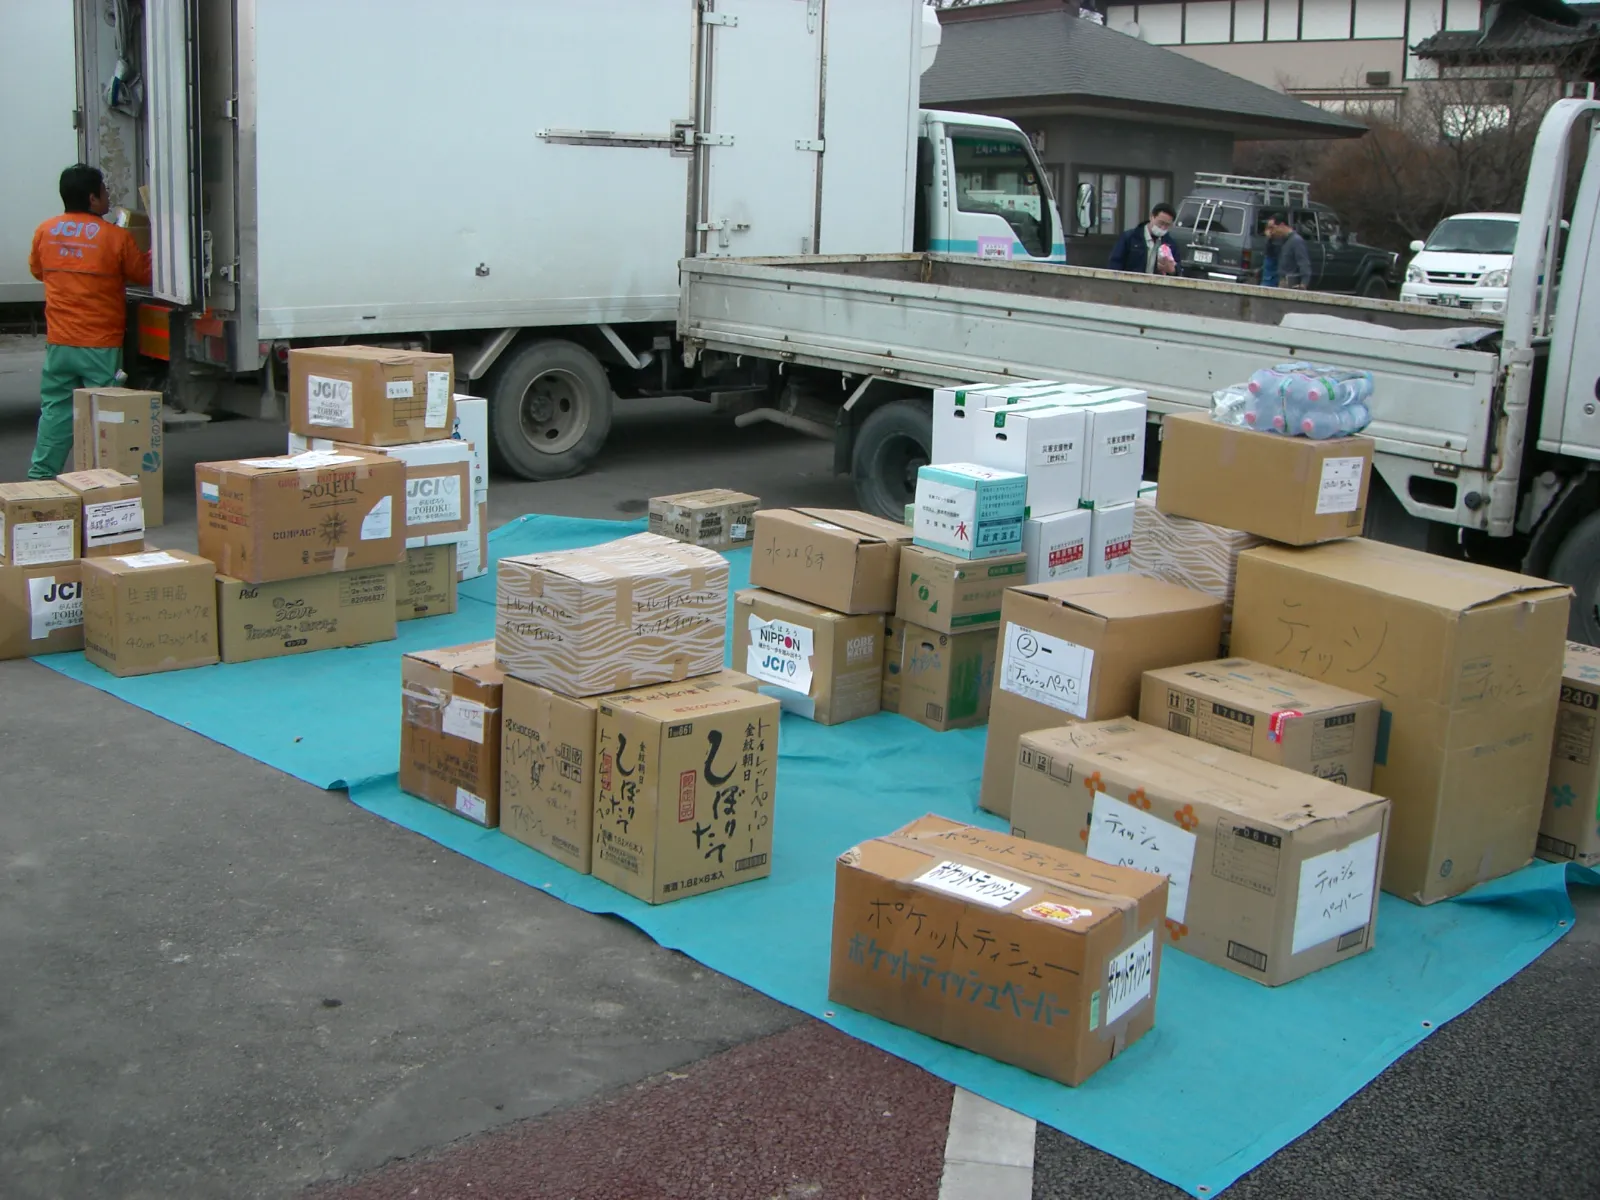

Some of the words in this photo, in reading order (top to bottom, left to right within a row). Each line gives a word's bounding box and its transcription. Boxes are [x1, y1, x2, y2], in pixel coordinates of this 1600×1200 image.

[50, 221, 84, 237] JCI
[313, 381, 337, 399] JCI
[301, 478, 364, 501] SOLEIL
[407, 479, 440, 498] JCI
[413, 503, 450, 515] TOHOKU
[272, 527, 317, 540] COMPACT
[954, 520, 969, 542] 水
[766, 537, 780, 565] 水
[44, 581, 83, 602] JCI
[239, 588, 258, 600] P&G
[760, 629, 800, 651] NIPPON
[762, 655, 785, 673] JCI
[742, 723, 756, 782] 金紋朝日
[692, 729, 746, 864] しぼりたて
[1104, 812, 1160, 851] ティッシュ
[929, 861, 1021, 902] ポケットティッシュ
[1314, 860, 1356, 895] ティッシュ
[1108, 941, 1151, 1010] ポケットティッシュ
